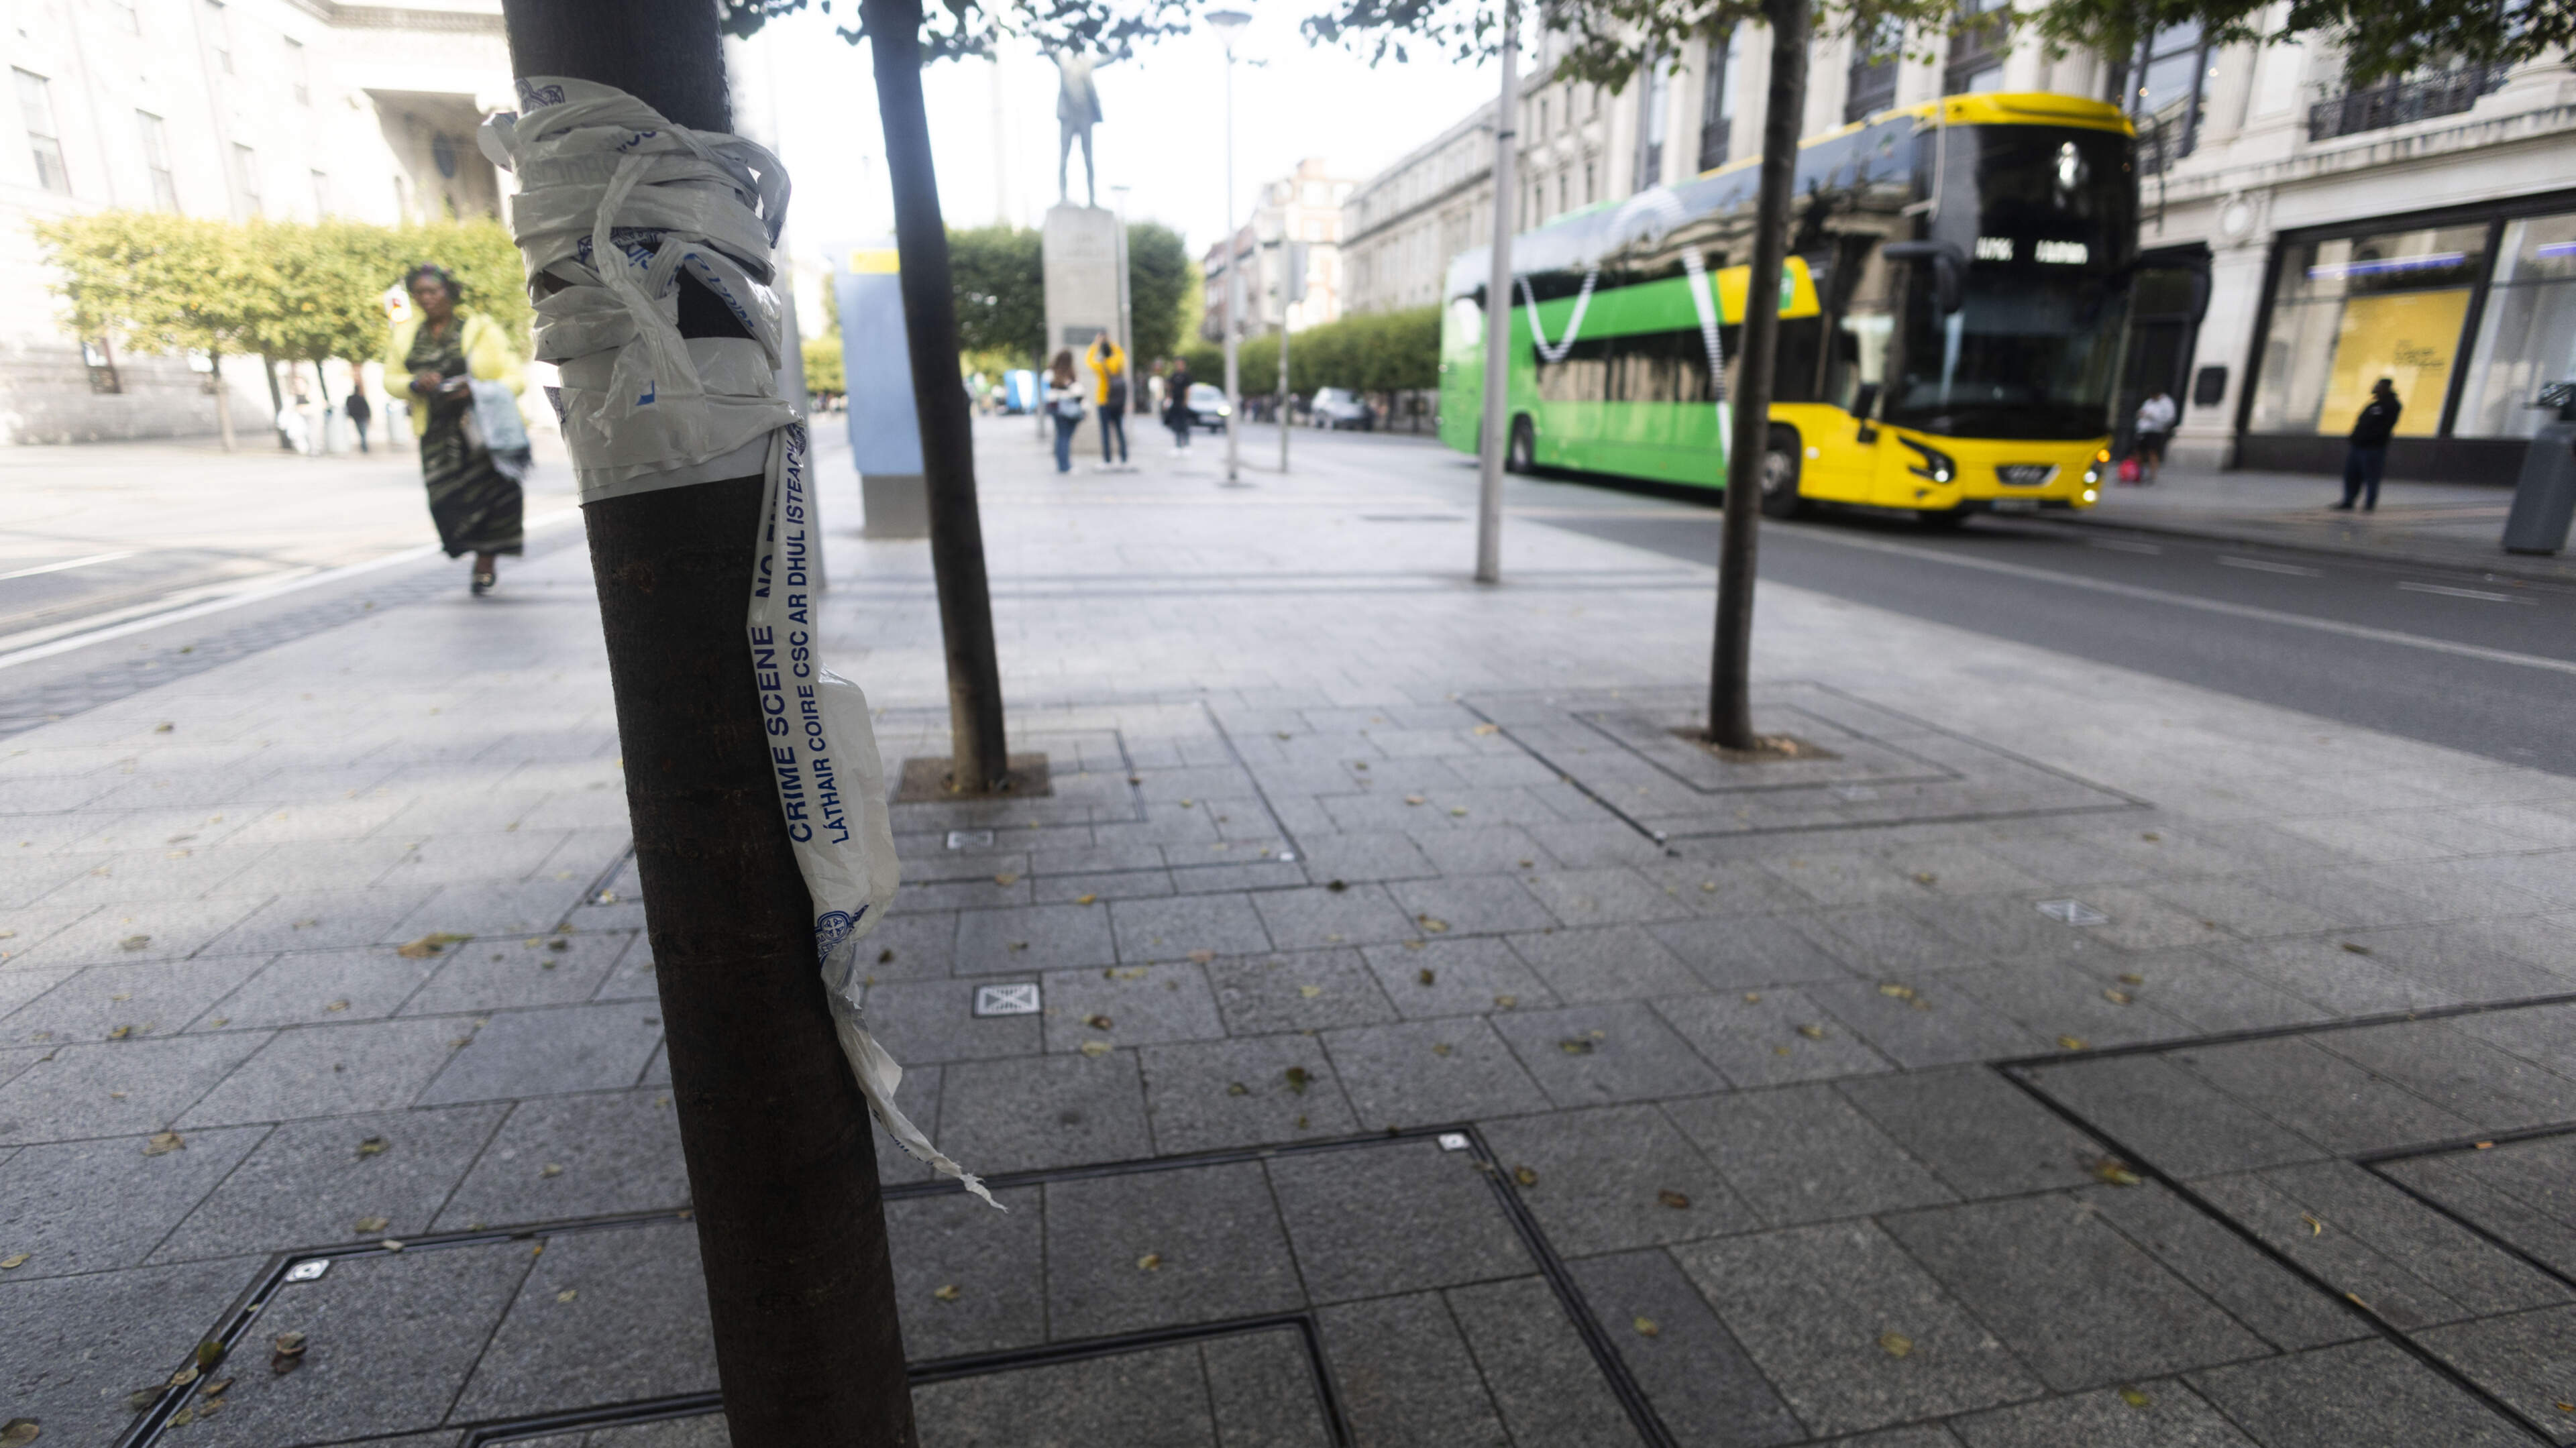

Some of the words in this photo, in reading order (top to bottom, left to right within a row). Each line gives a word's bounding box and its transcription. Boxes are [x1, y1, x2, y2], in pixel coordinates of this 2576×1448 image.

[787, 530, 807, 586] DHUL
[788, 594, 808, 624] AR
[751, 626, 789, 736] SCENE
[790, 631, 810, 678] CSC
[797, 685, 826, 752] COIRE
[772, 746, 813, 842] CRIME
[813, 758, 849, 844] LÁTHAIR
